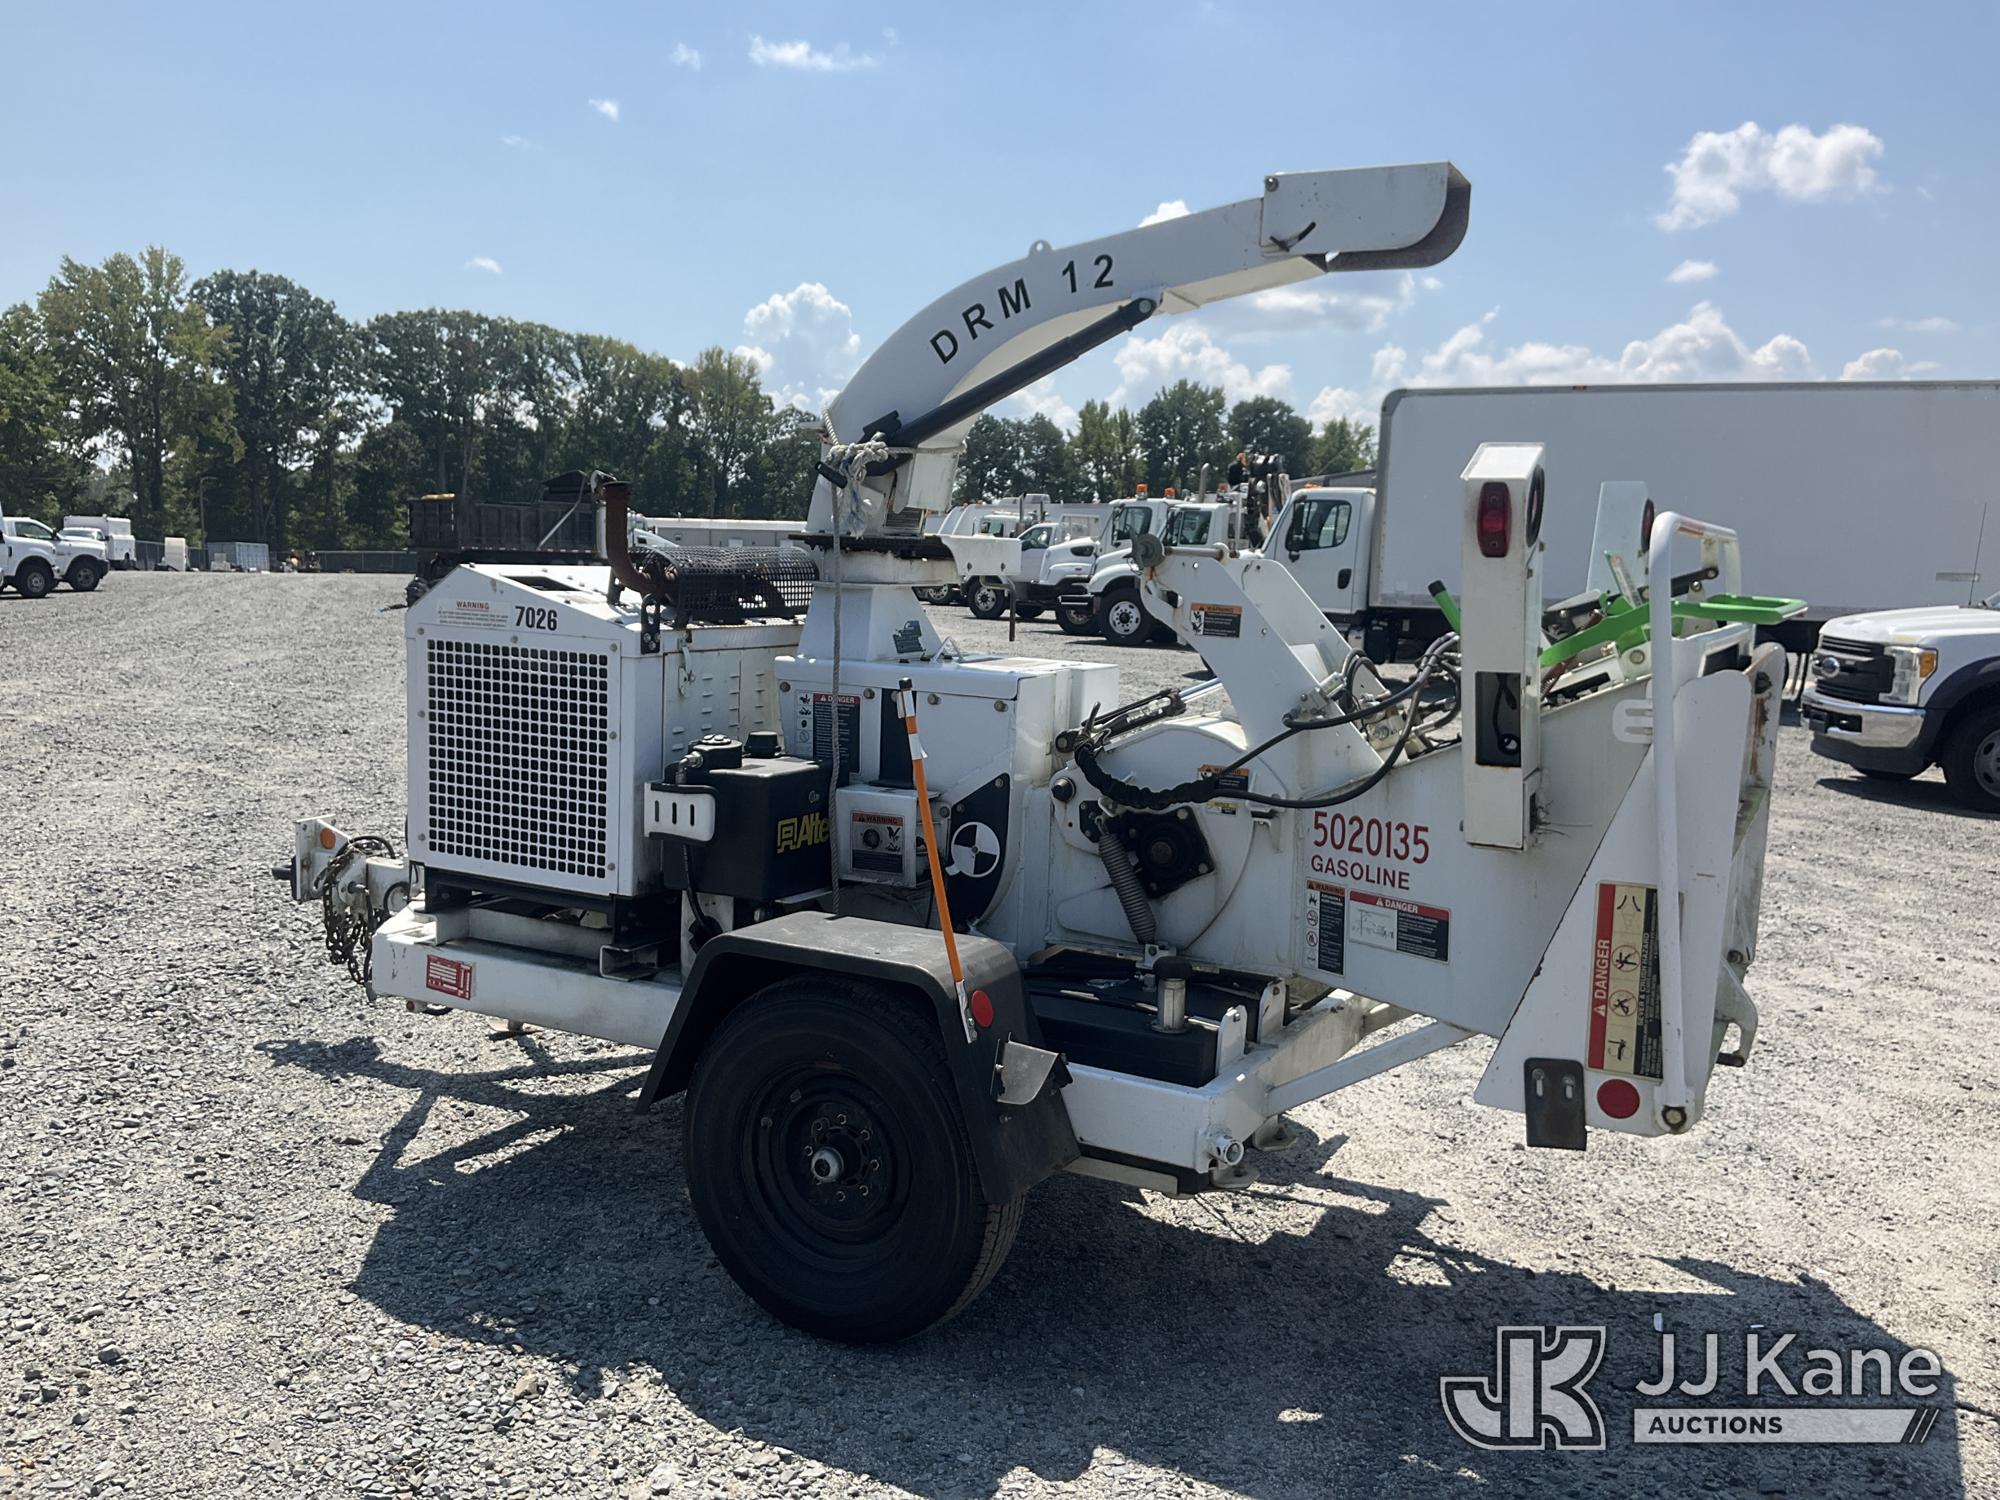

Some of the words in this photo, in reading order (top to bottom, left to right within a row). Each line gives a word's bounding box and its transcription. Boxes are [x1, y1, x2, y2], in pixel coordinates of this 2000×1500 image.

[930, 278, 1031, 364] DRM
[1062, 254, 1114, 293] 12
[456, 601, 490, 610] WARNING
[515, 605, 558, 631] 7026
[866, 816, 898, 825] WARNING
[1313, 811, 1430, 864] 5020135
[1311, 855, 1410, 890] GASOLINE
[1315, 882, 1345, 895] WARNING
[1385, 899, 1418, 913] DANGER
[1641, 932, 1650, 965] HAZARD
[1594, 939, 1610, 999] DANGER
